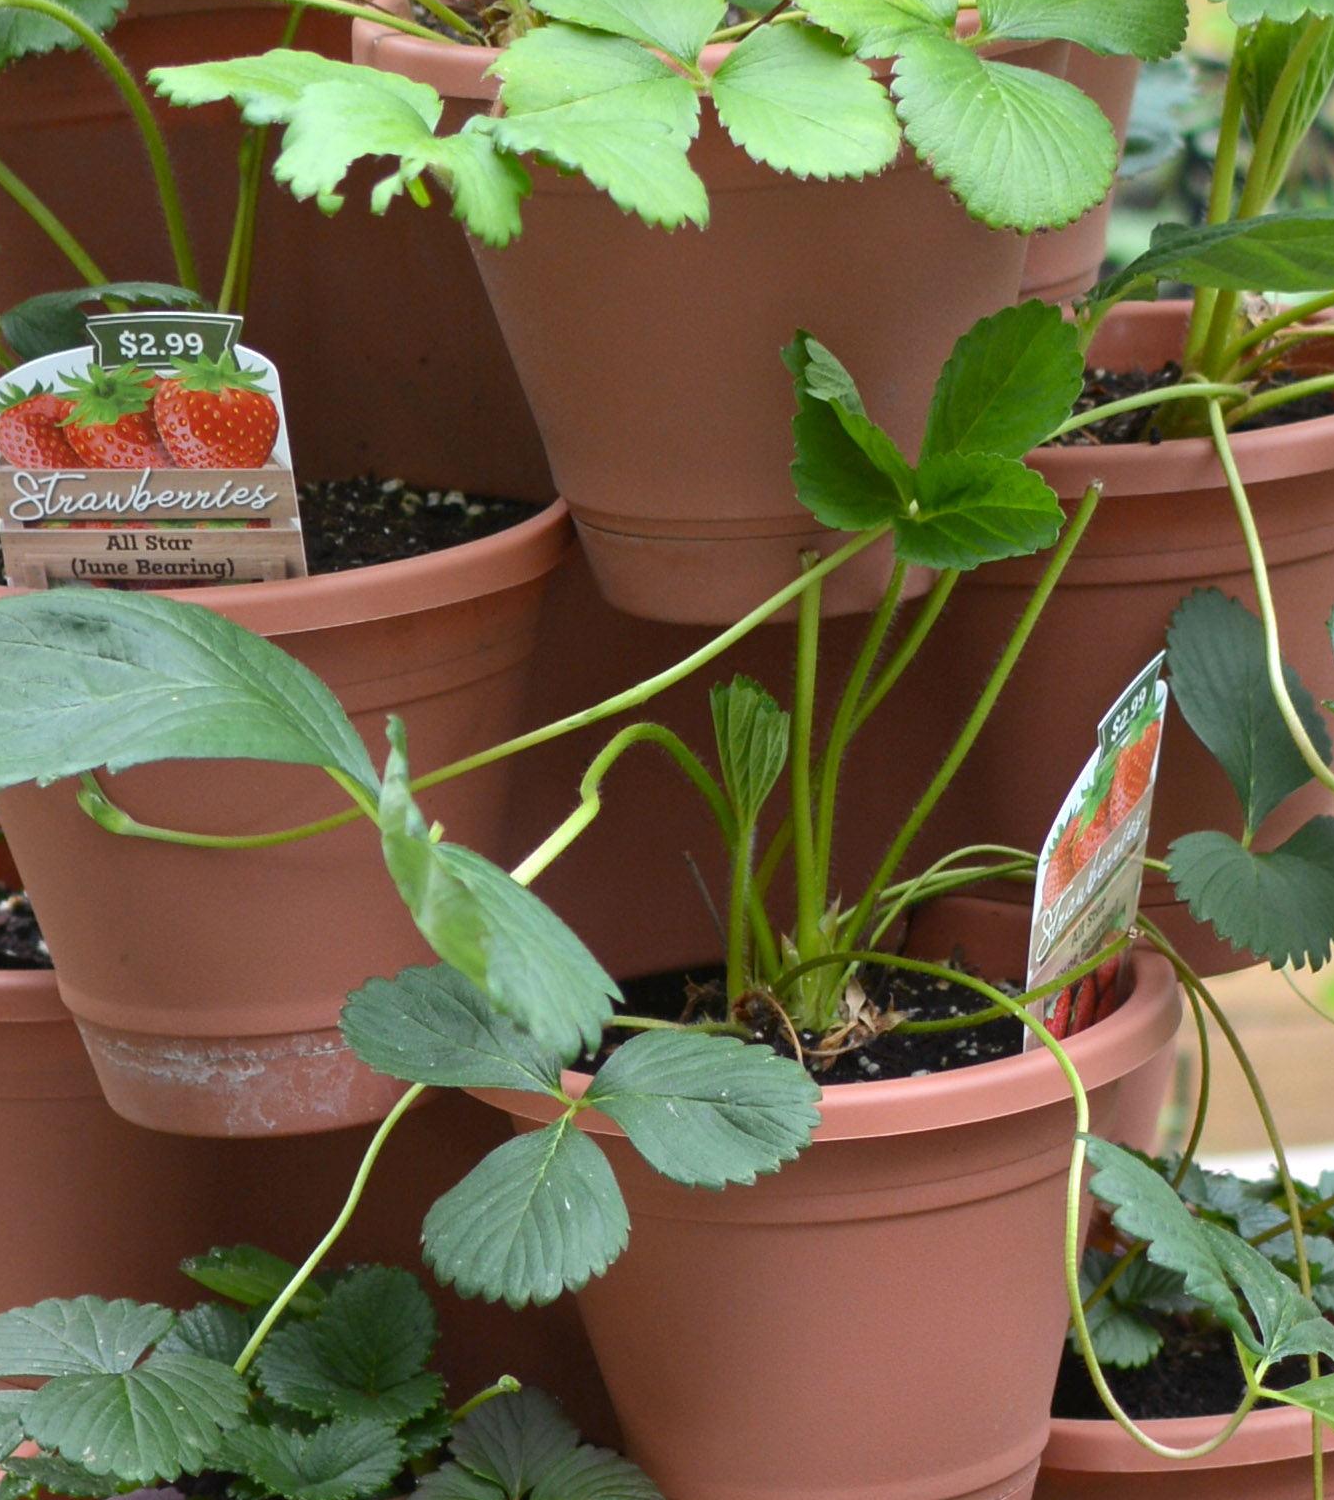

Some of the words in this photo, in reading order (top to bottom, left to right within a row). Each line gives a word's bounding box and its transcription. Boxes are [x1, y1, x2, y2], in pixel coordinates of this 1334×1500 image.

[118, 330, 204, 359] $2.99
[9, 466, 278, 522] Strawberries
[106, 535, 138, 551] All
[145, 535, 193, 551] Star
[70, 558, 129, 577] (June
[136, 557, 235, 581] Bearing)
[1111, 686, 1147, 742] $2.99
[1035, 810, 1146, 963] Strawberries
